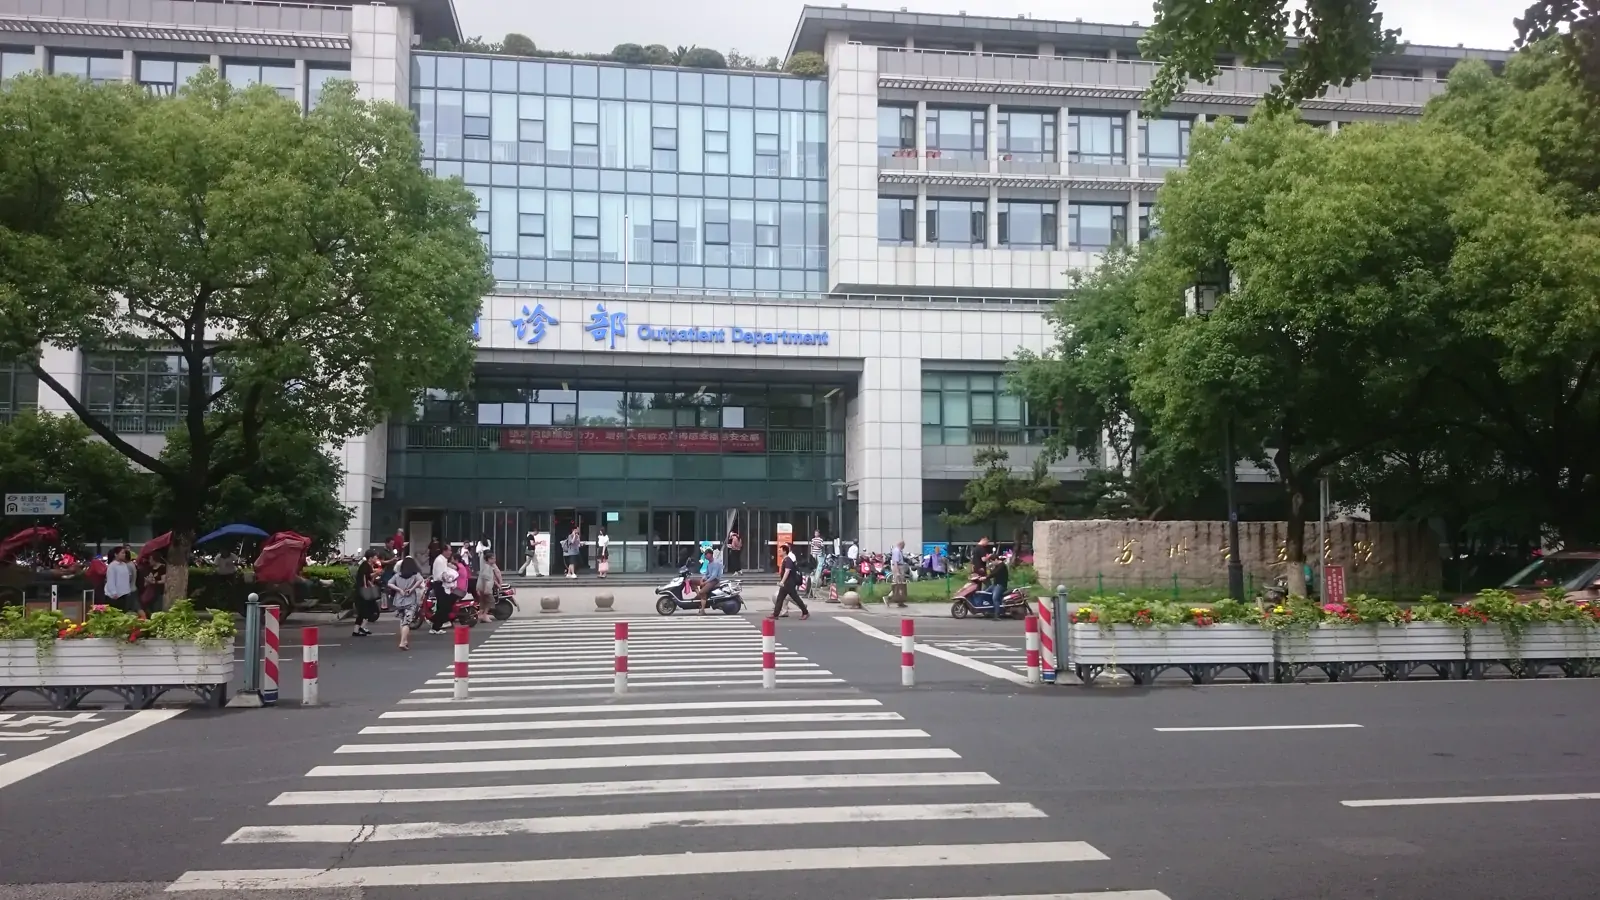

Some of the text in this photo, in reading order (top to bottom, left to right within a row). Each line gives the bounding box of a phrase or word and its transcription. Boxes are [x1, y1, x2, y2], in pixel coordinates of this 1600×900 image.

[472, 303, 628, 349] 诊部
[637, 324, 829, 346] Outpatient Department
